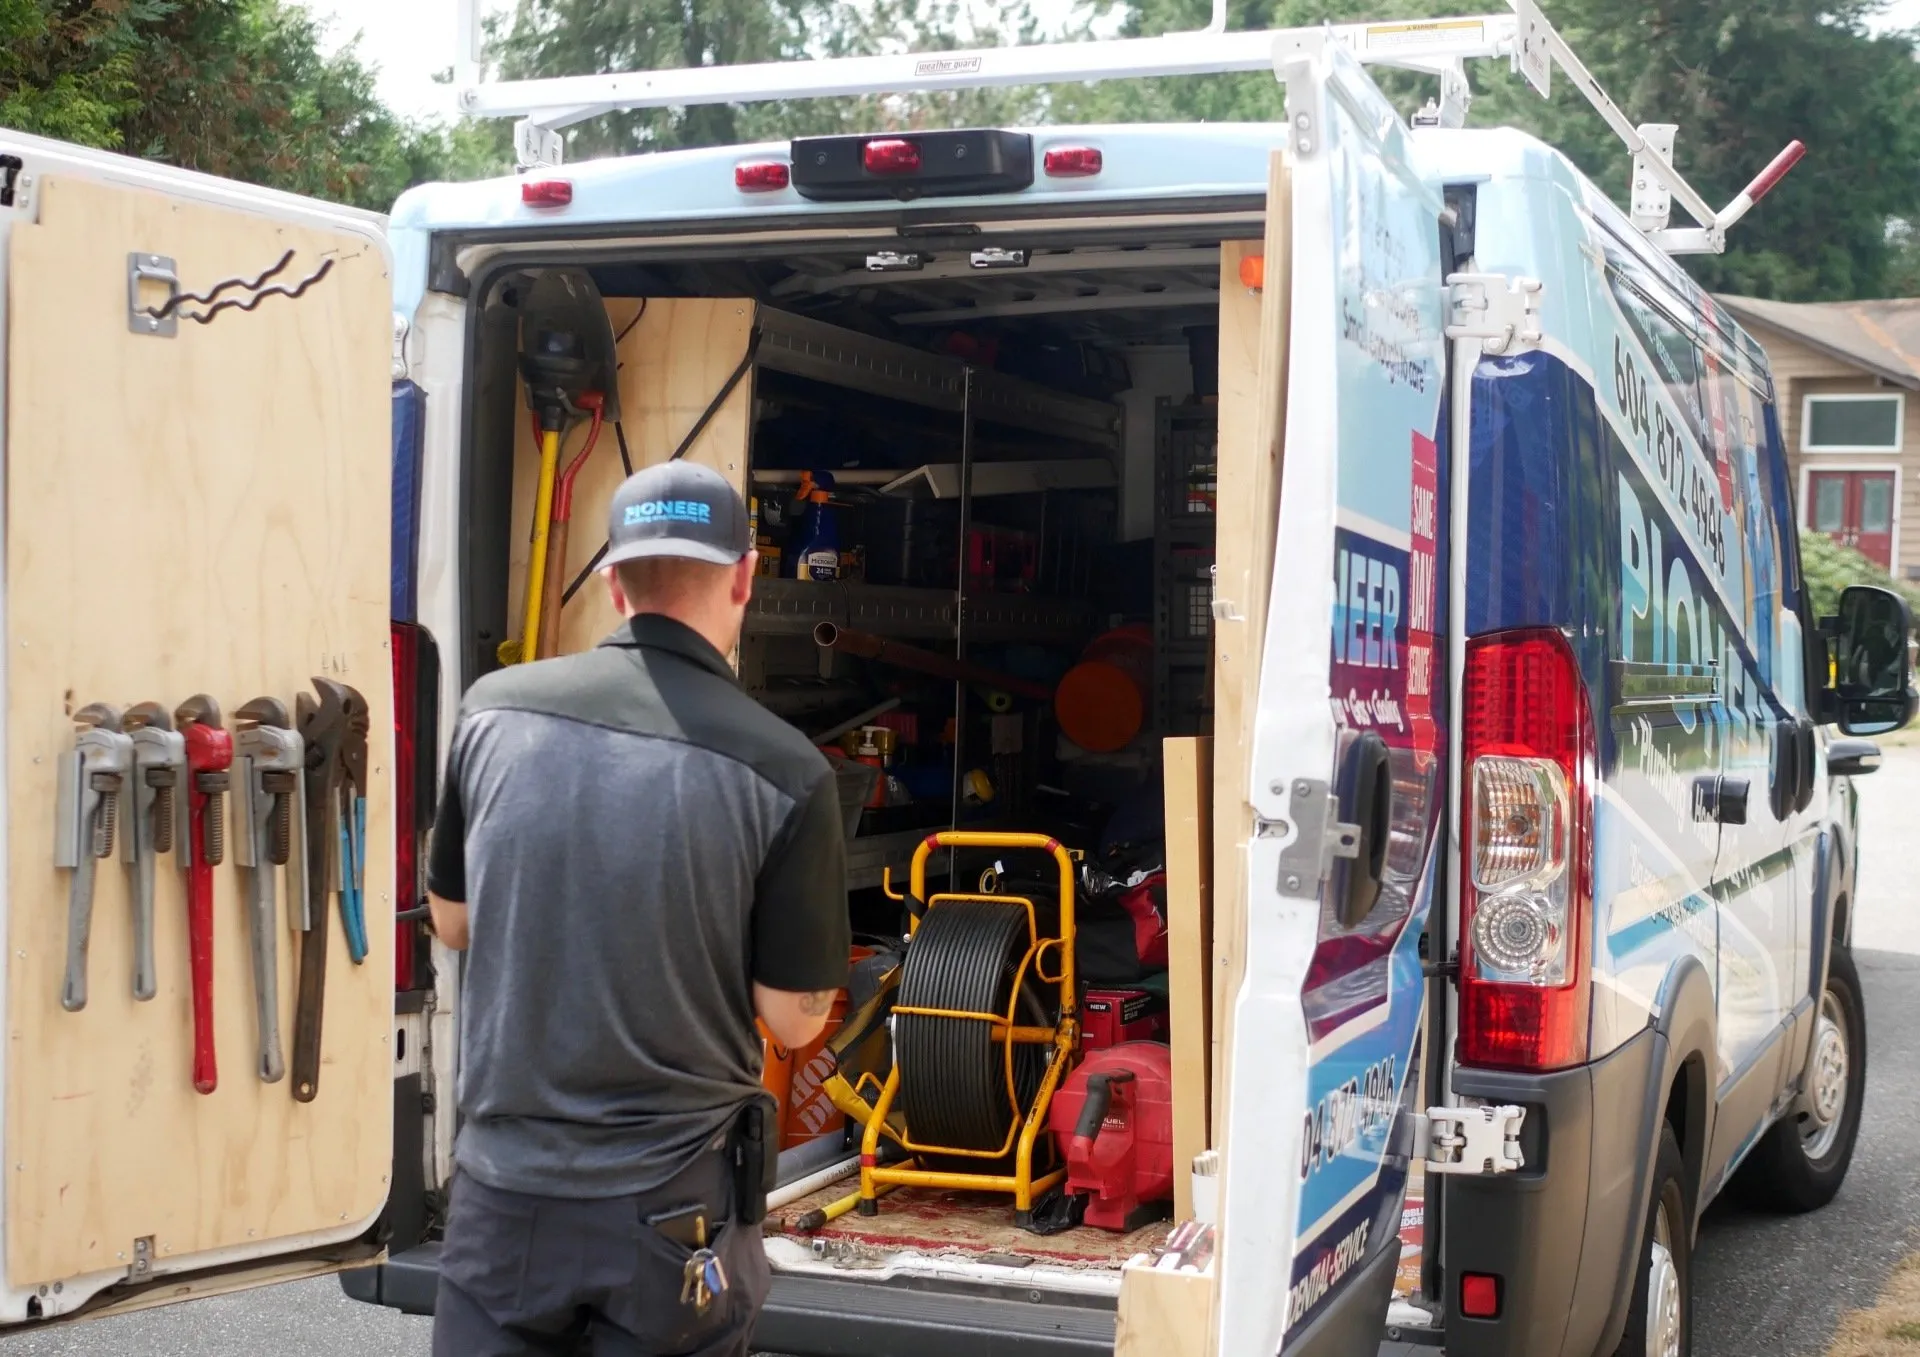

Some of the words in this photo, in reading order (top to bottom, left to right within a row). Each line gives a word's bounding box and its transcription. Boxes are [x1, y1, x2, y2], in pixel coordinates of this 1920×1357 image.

[1614, 329, 1651, 455] 604
[1656, 399, 1688, 518] 872
[1691, 463, 1726, 578] 4946
[1413, 484, 1434, 540] SAME
[1411, 550, 1433, 632] DAY
